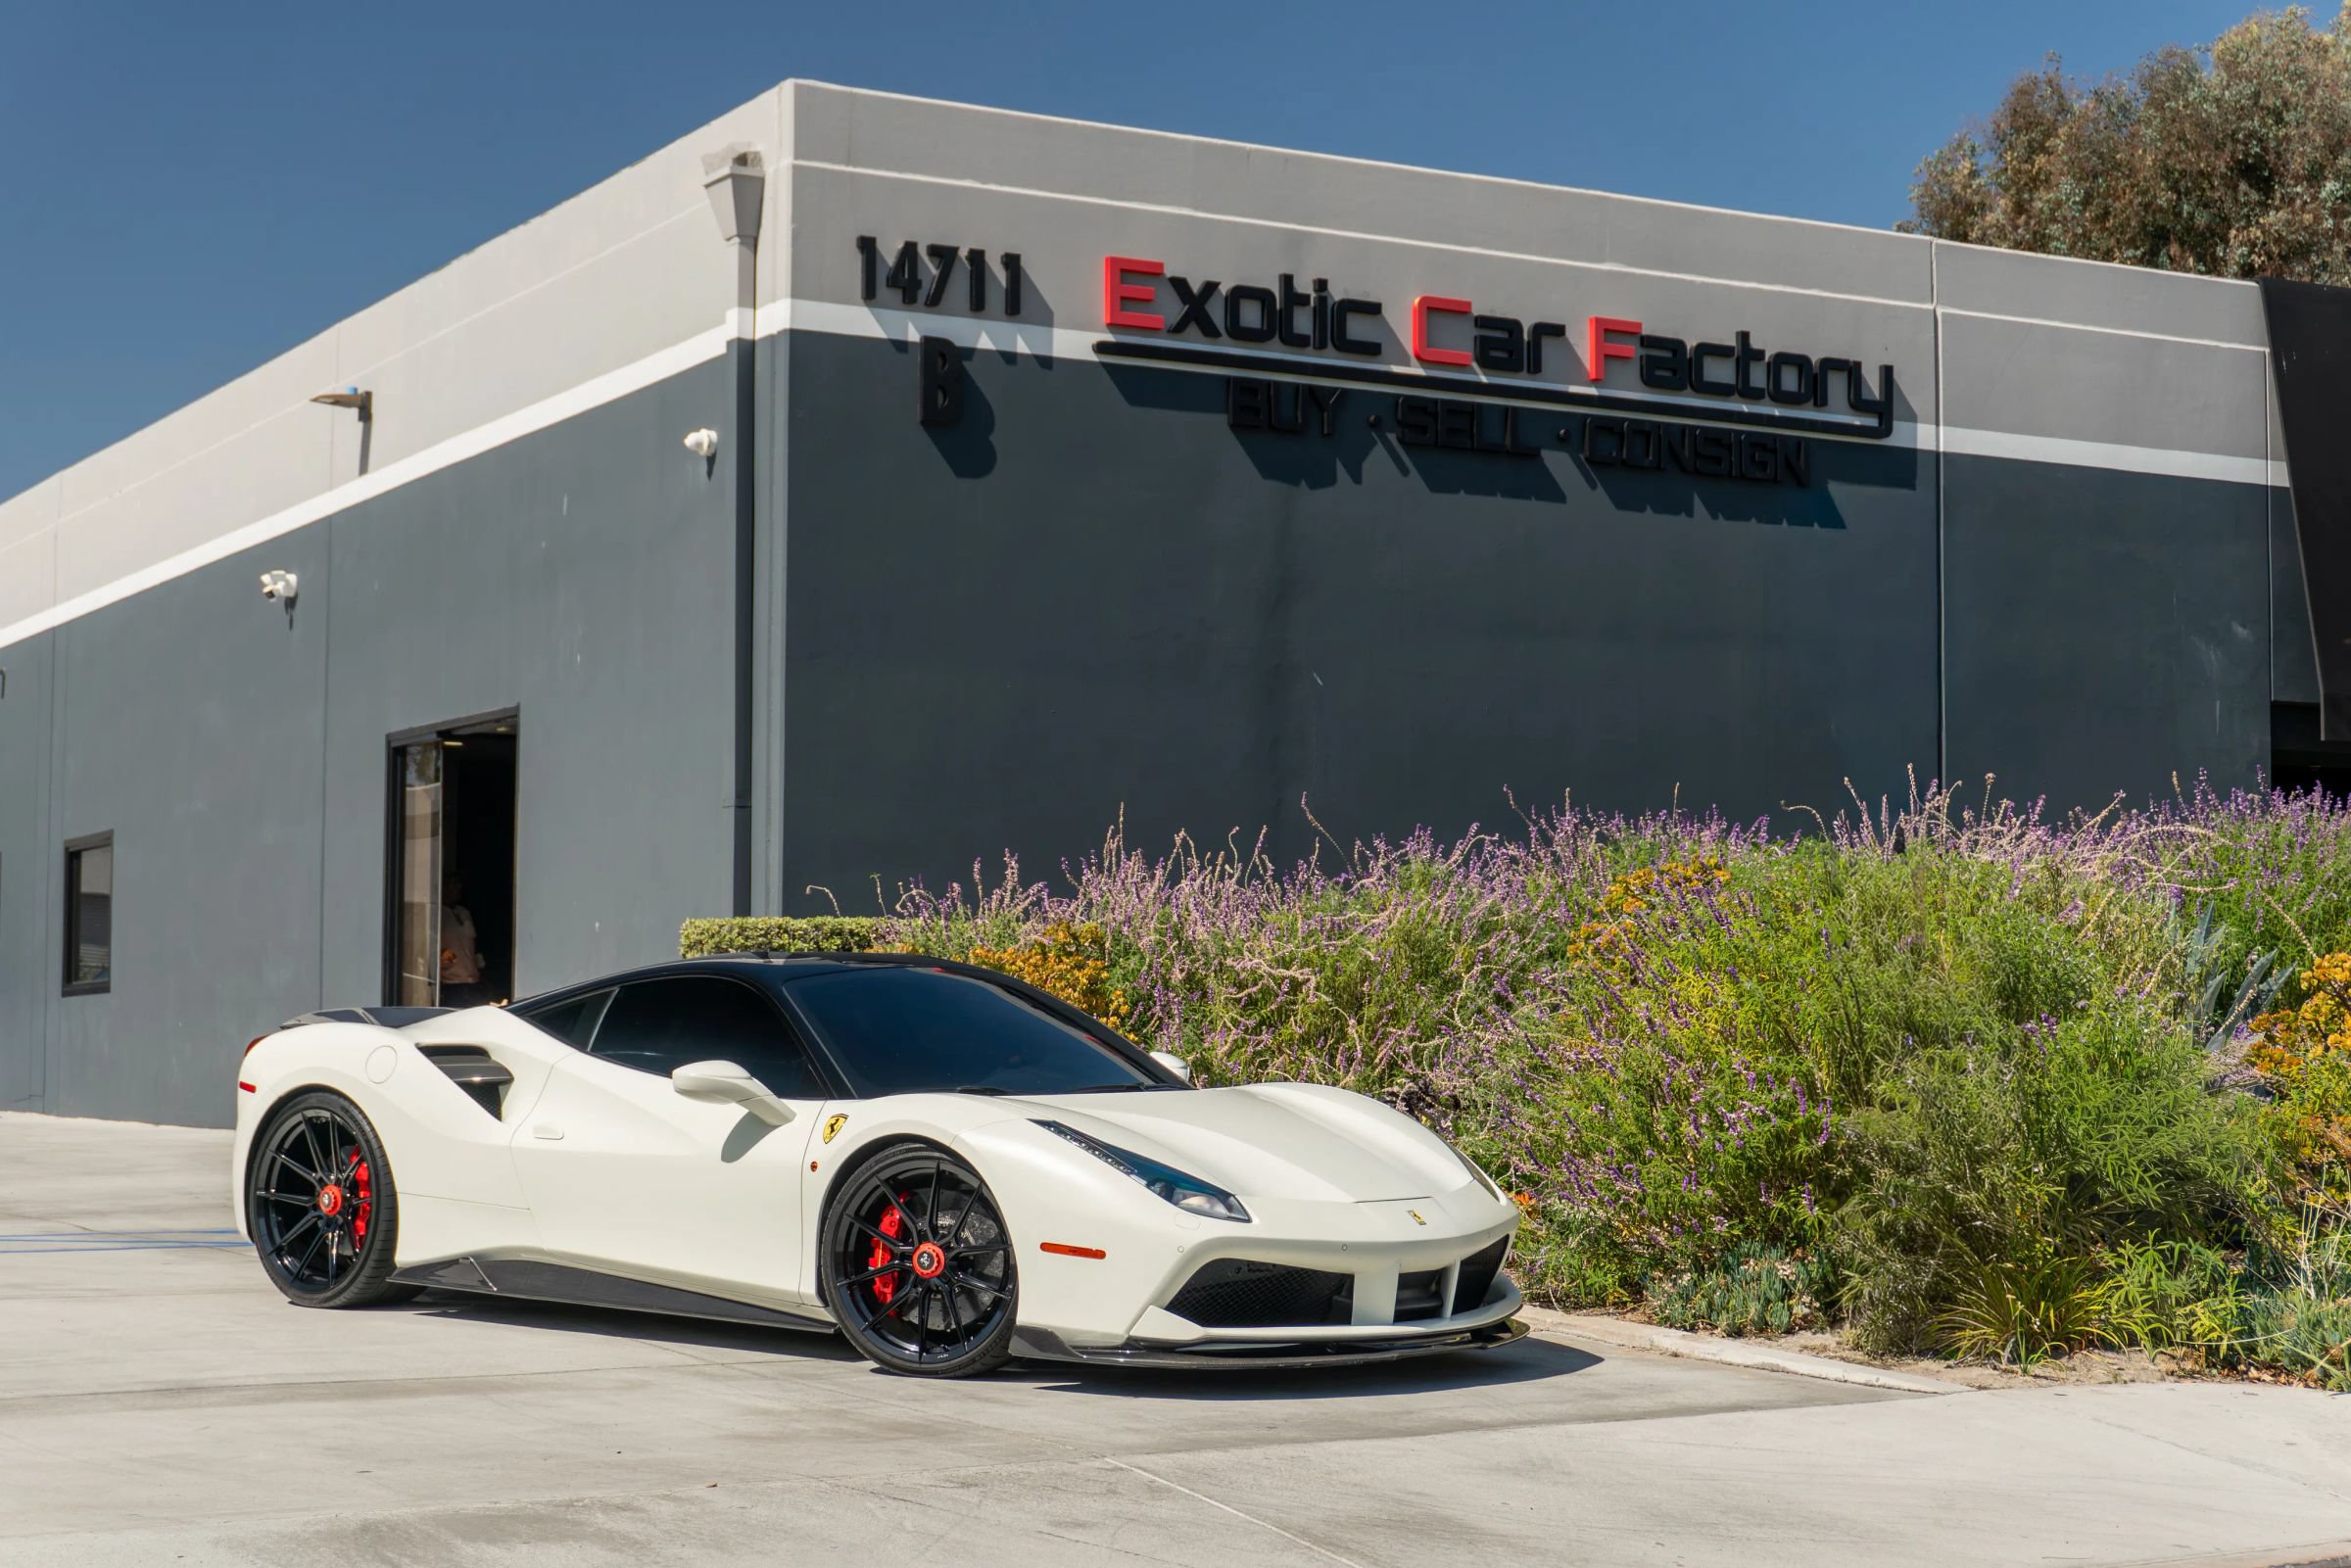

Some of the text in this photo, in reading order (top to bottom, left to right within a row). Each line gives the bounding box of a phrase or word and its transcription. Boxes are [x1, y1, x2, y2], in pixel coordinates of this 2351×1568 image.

[856, 236, 1022, 315] 14711
[918, 336, 966, 424] B
[1104, 256, 1894, 438] Exotic Car Factory
[1226, 375, 1810, 487] BUY SELL CONSIGN
